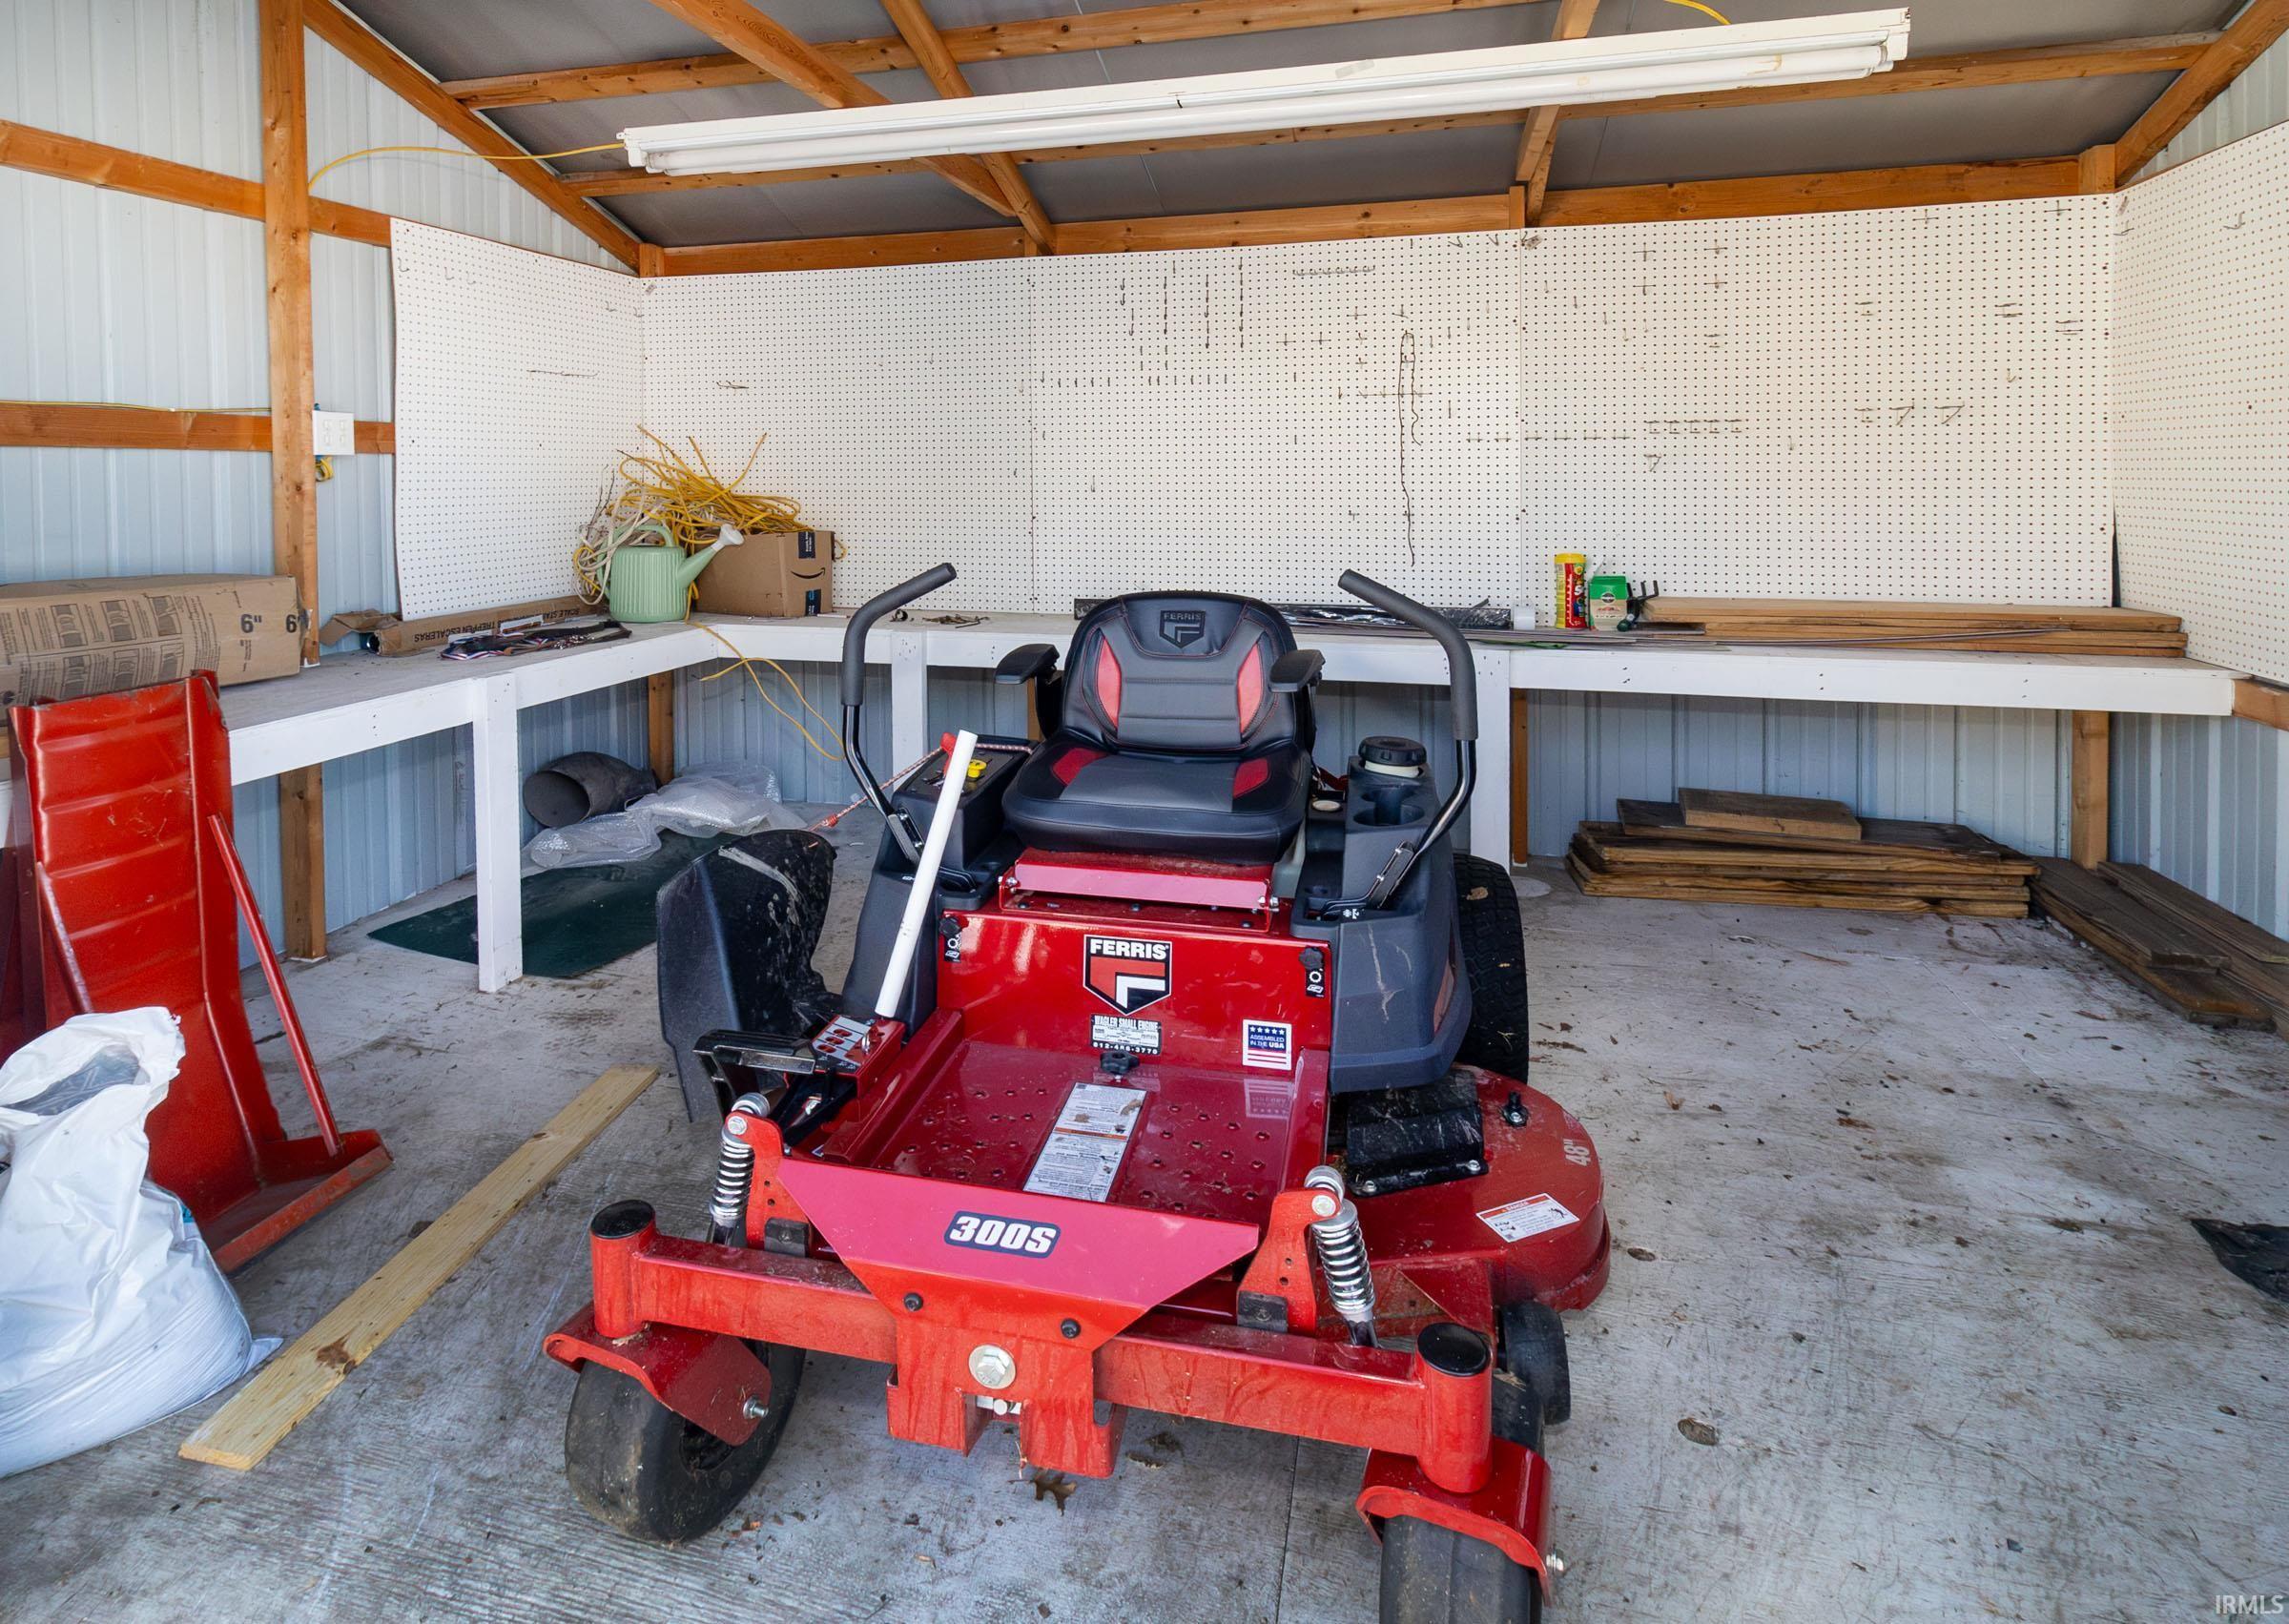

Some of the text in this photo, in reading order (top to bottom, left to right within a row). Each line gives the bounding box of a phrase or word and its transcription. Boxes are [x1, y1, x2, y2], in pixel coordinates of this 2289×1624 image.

[240, 613, 262, 633] 6"
[414, 626, 463, 642] ESCALERAS
[1090, 938, 1167, 960] FERRIS
[1118, 1018, 1138, 1030] SMALL
[1249, 1034, 1285, 1042] ASSEMBLED
[949, 1216, 1057, 1253] 300S
